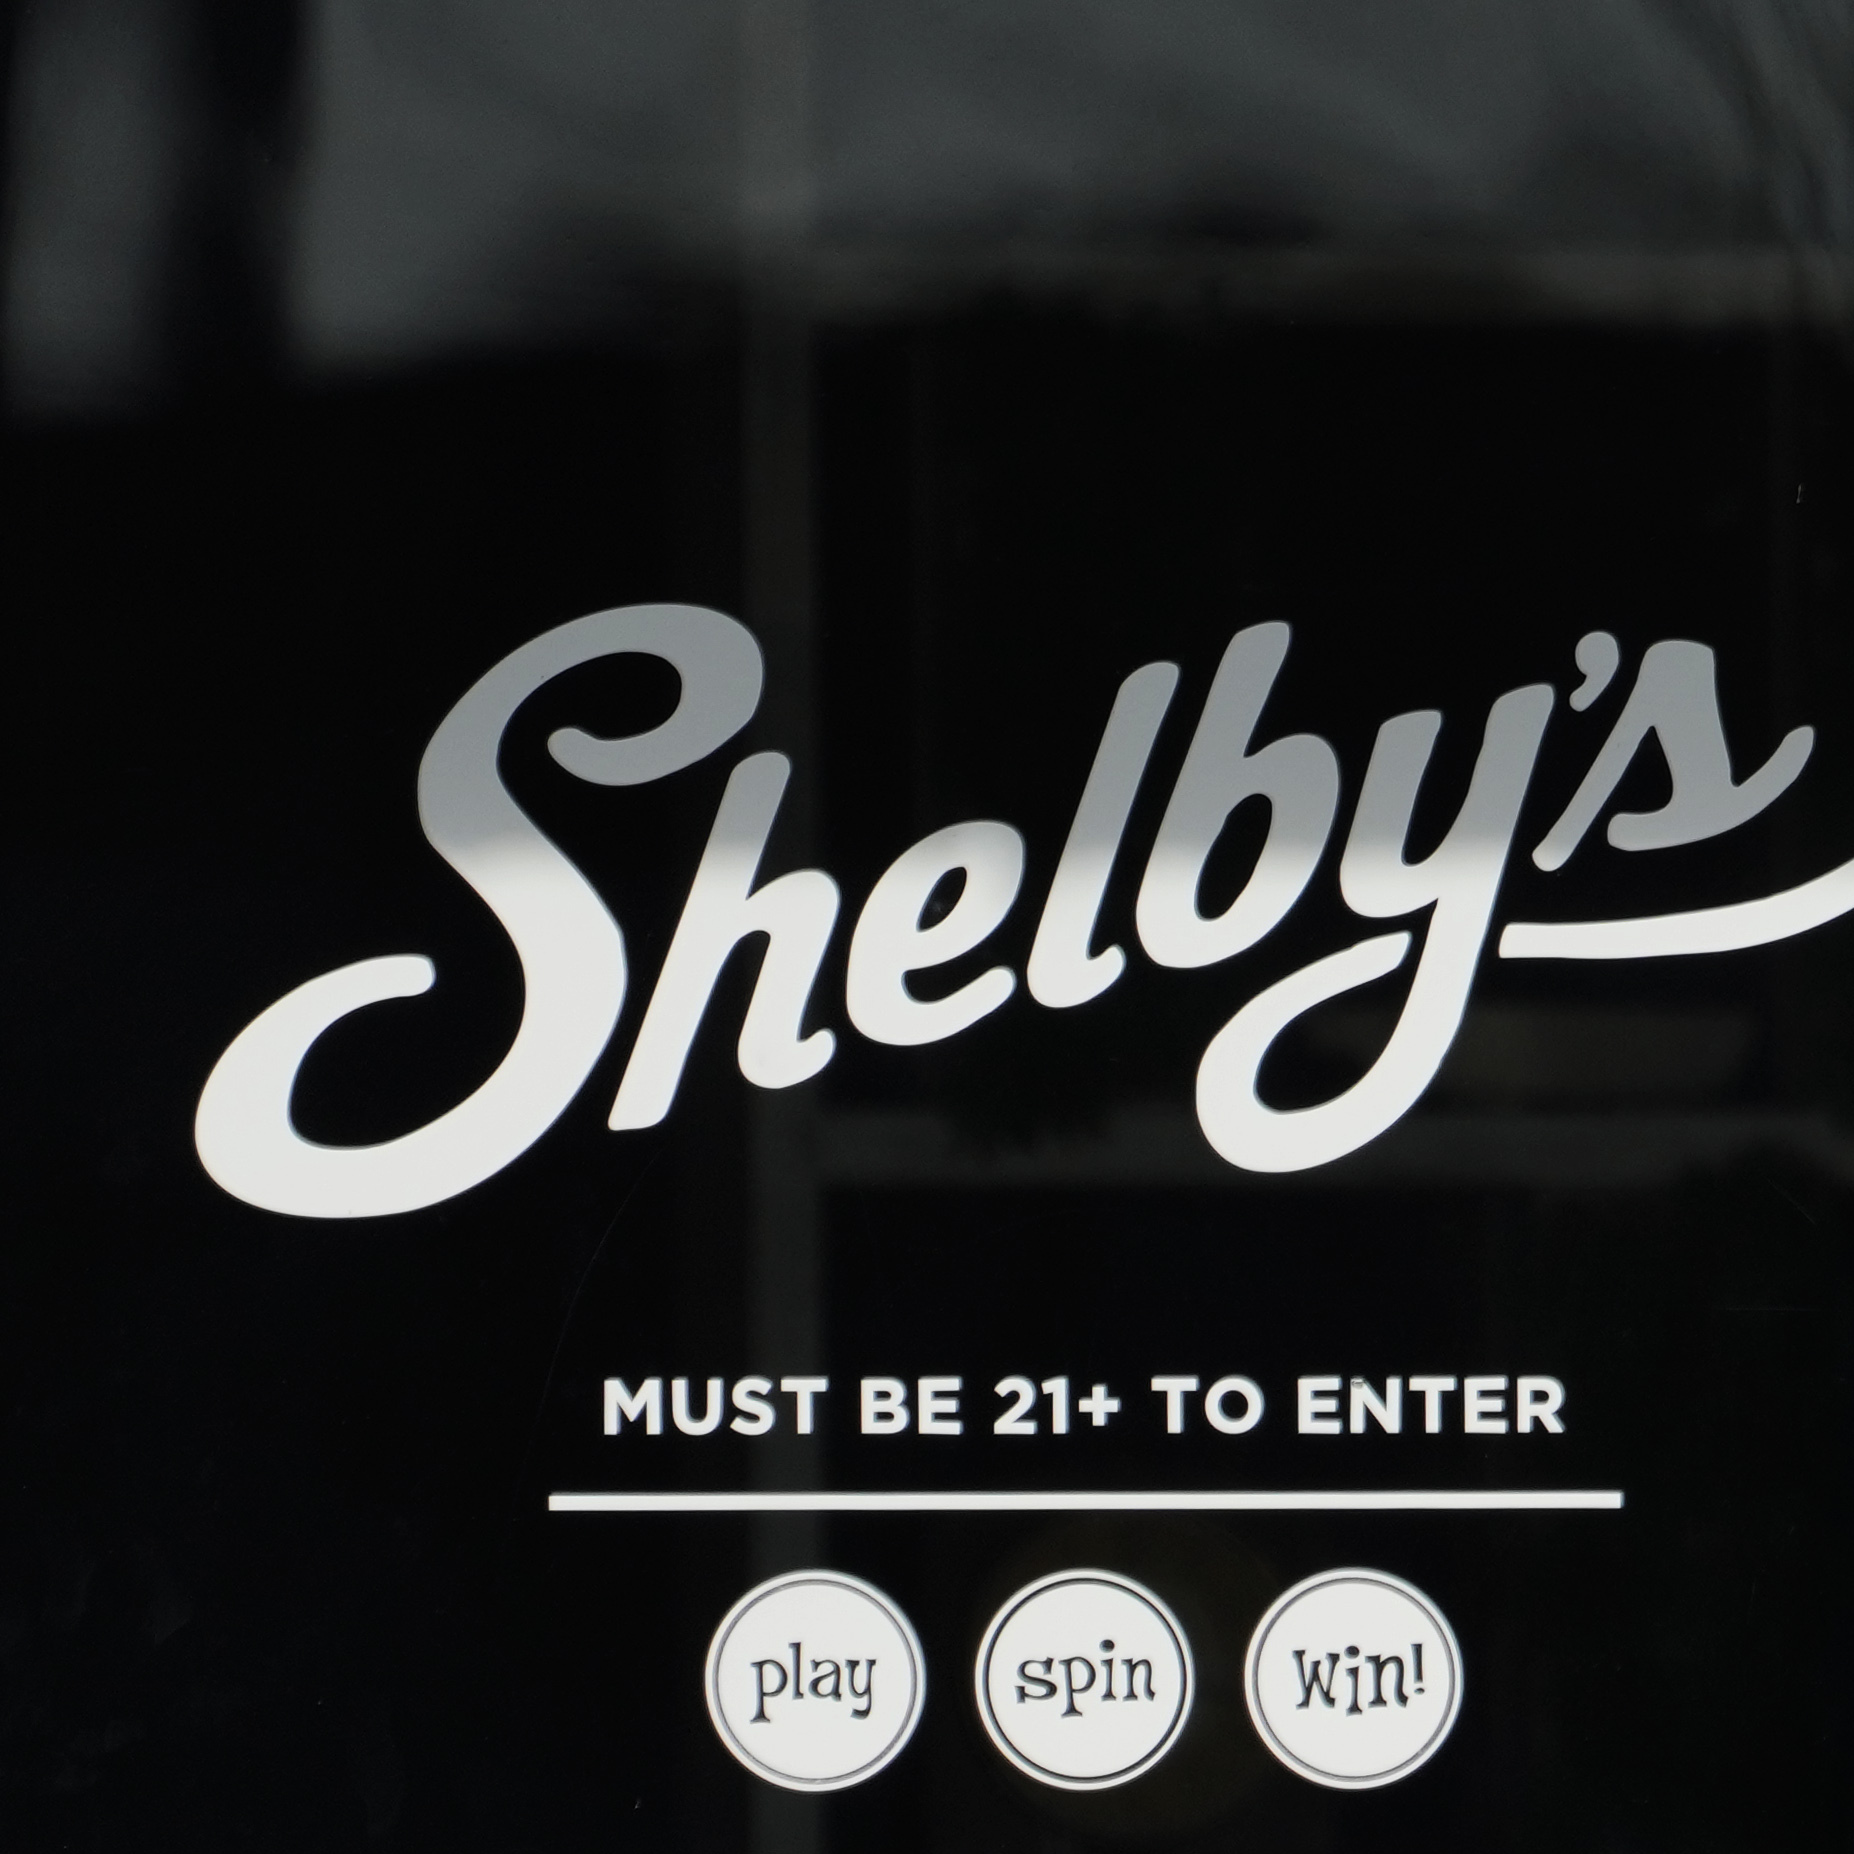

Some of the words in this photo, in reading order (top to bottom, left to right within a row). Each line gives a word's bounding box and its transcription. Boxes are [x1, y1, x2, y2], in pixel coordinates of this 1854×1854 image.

[605, 1378, 827, 1435] MUST
[861, 1378, 960, 1434] BE
[994, 1378, 1118, 1434] 21+
[1152, 1378, 1262, 1433] TO
[1298, 1377, 1562, 1434] ENTER
[749, 1641, 878, 1723] play
[1014, 1638, 1157, 1717] spin
